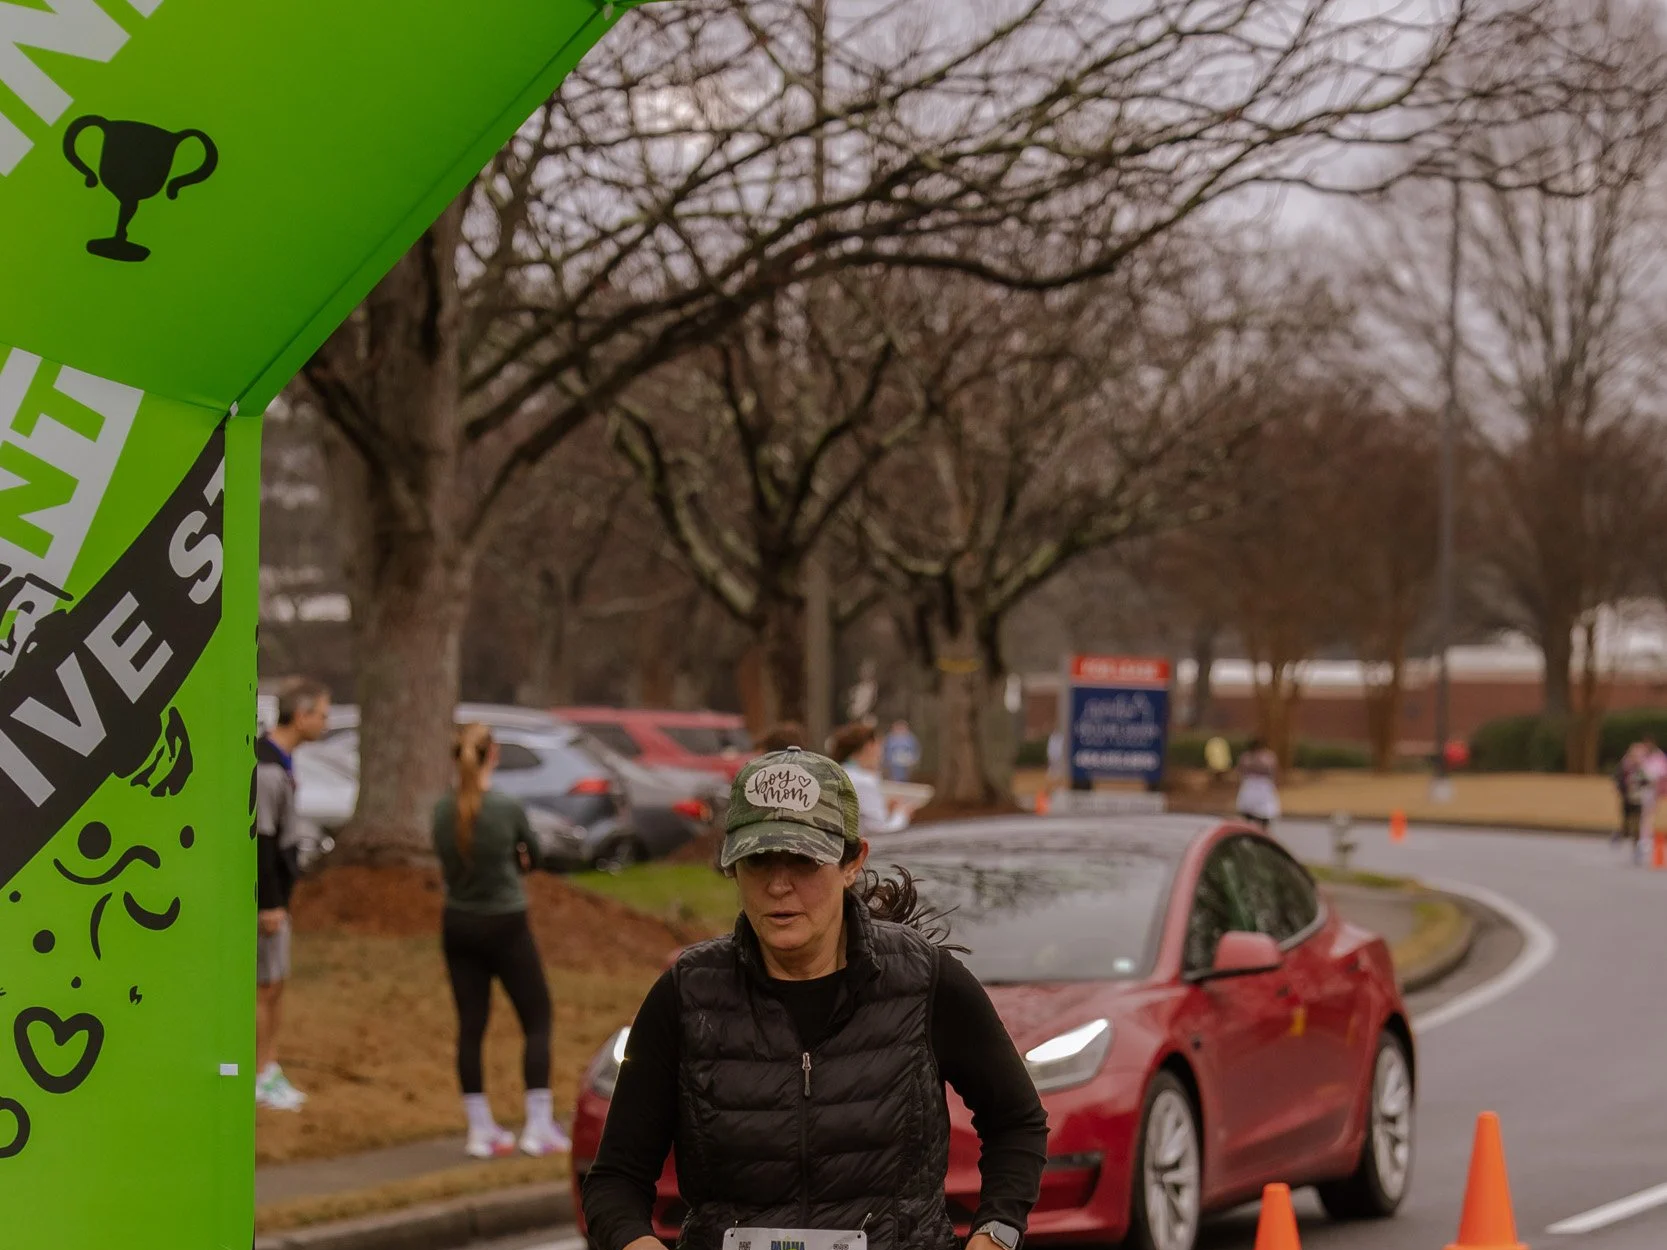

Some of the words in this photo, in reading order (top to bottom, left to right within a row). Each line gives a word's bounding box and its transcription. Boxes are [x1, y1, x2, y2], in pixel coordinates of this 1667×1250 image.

[168, 456, 225, 604] S
[748, 769, 796, 794] boy
[763, 786, 810, 807] mom
